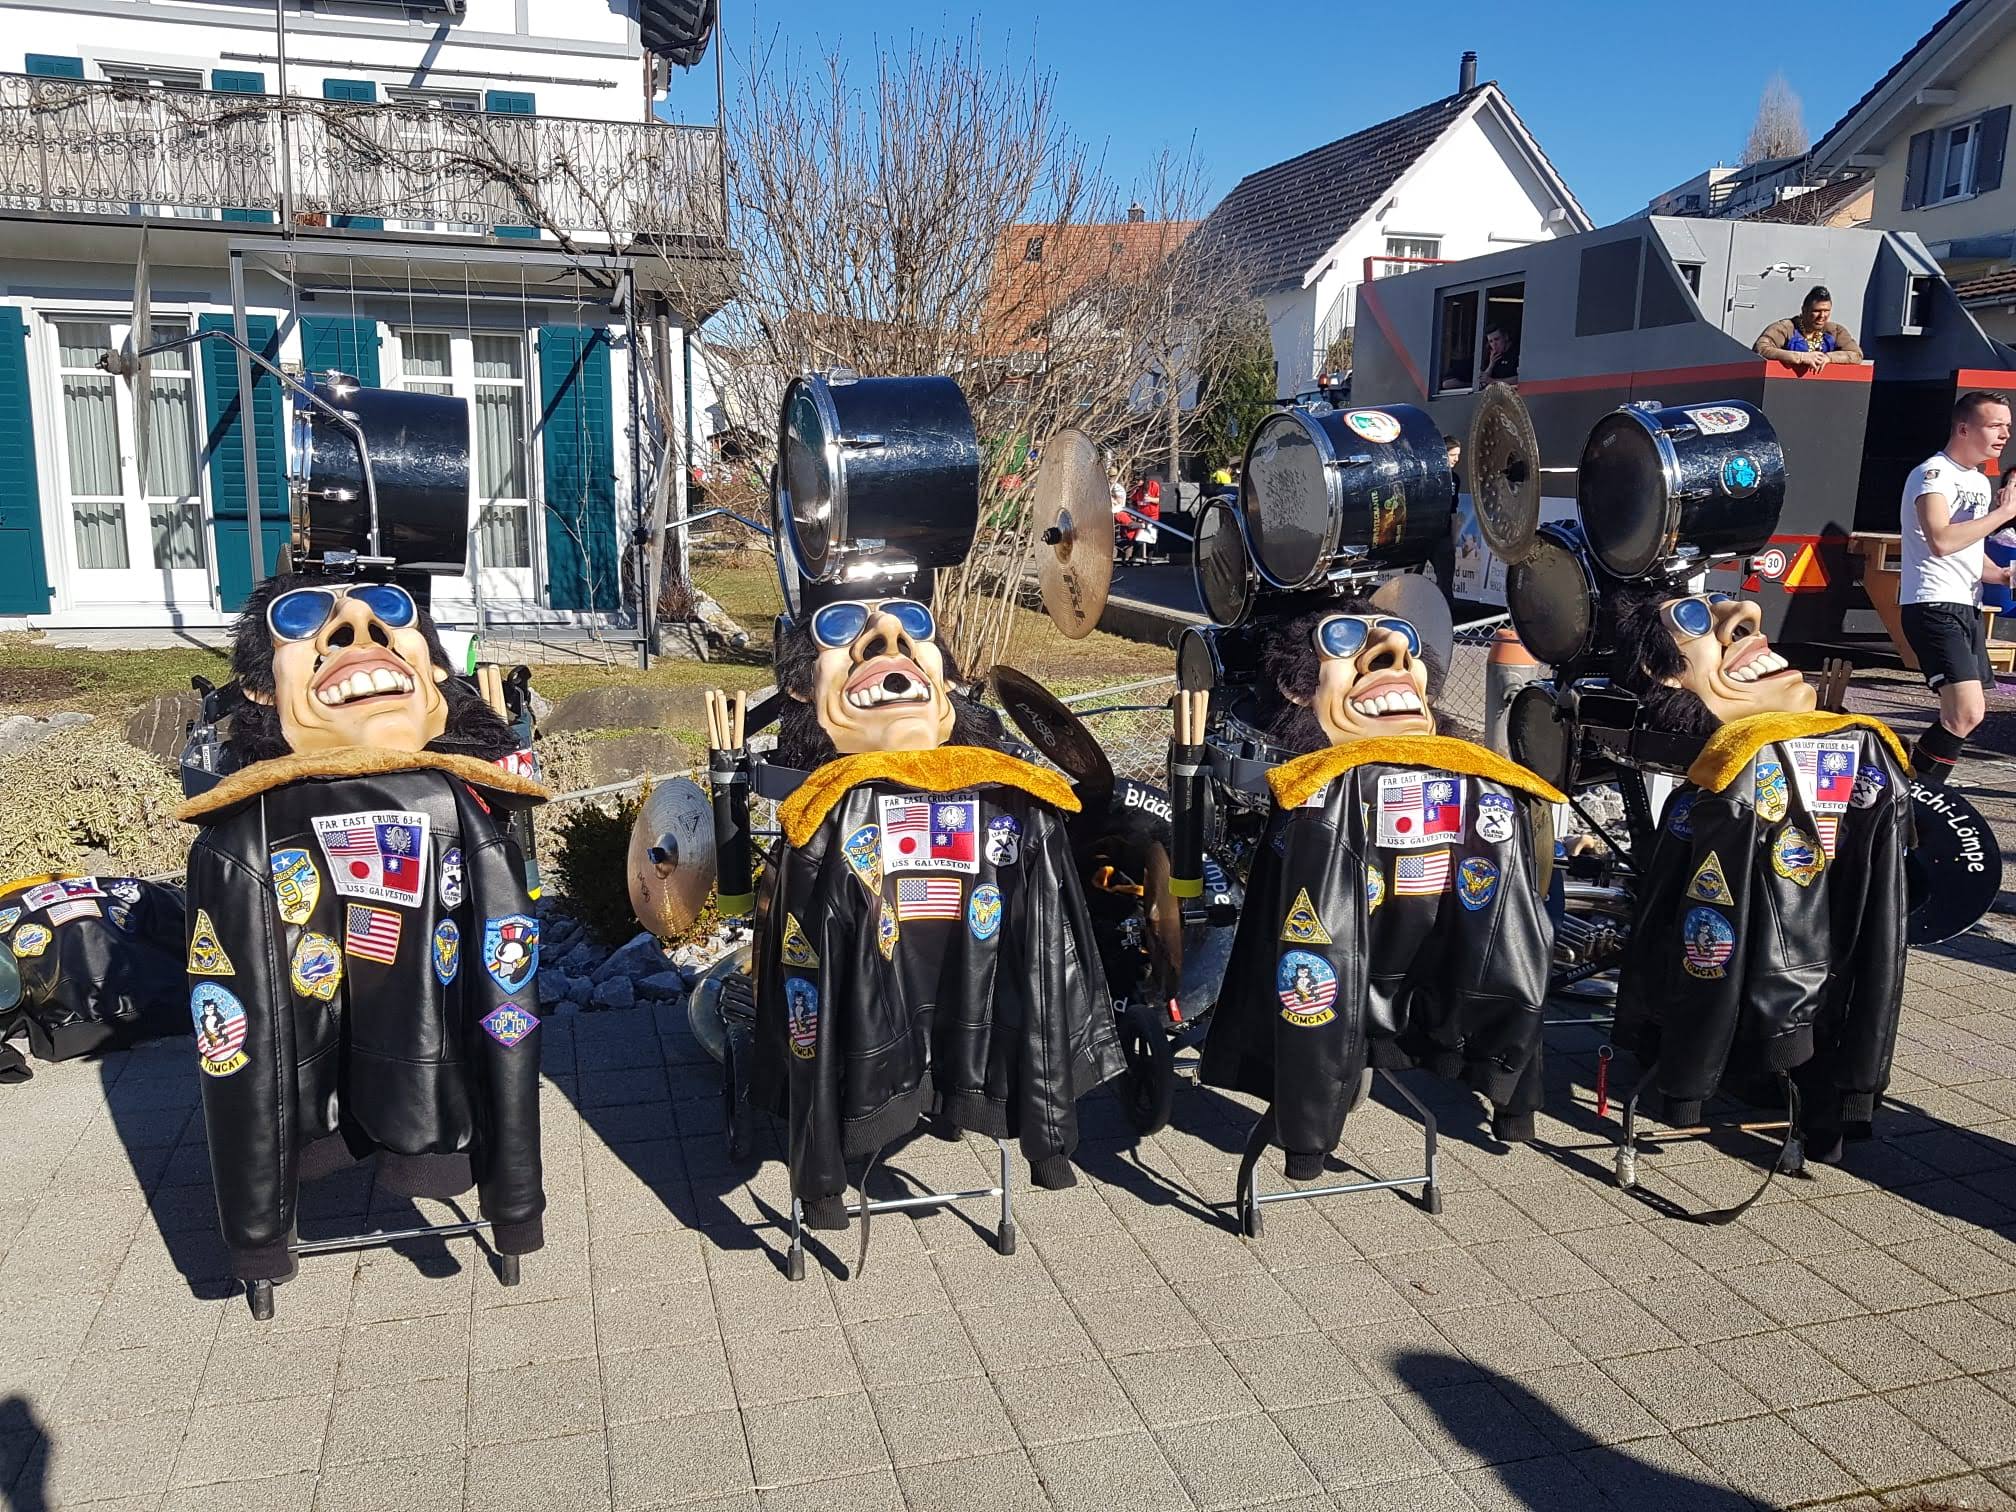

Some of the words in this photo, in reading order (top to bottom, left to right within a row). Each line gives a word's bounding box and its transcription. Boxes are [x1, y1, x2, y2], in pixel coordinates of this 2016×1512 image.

[1768, 558, 1779, 568] 30
[1383, 777, 1398, 786] FAR
[1400, 775, 1417, 784] EAST
[884, 799, 900, 808] FAR
[904, 796, 924, 804] EAST
[927, 793, 956, 802] CRUISE
[319, 820, 338, 830] FAR
[343, 816, 366, 827] EAST
[372, 815, 400, 825] CRUISE
[403, 816, 422, 825] 63-4
[1387, 838, 1405, 846] USS
[1410, 832, 1457, 845] GALVESTON
[892, 860, 910, 868] USS
[914, 859, 972, 870] GALVESTON
[346, 884, 366, 894] USS
[369, 886, 415, 903] GALVESTON
[490, 1019, 509, 1033] TOP
[512, 1018, 528, 1033] TEN
[1285, 1011, 1331, 1026] TOMCAT
[204, 1057, 241, 1074] TOMCAT
